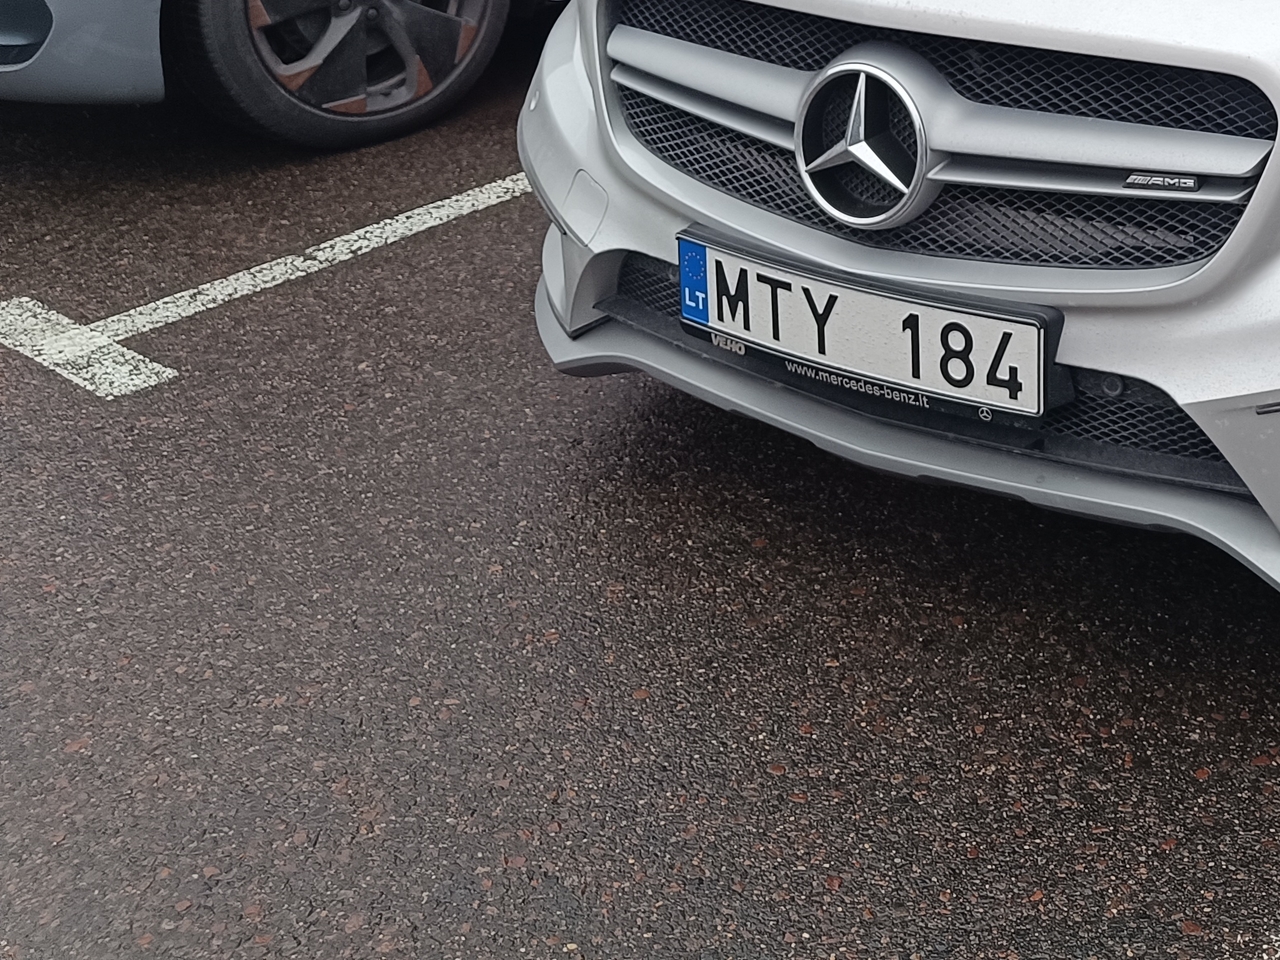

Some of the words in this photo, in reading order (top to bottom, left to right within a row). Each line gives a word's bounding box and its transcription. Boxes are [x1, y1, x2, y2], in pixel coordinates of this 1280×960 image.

[1147, 176, 1195, 188] AMG
[684, 286, 706, 310] LT
[714, 257, 839, 356] MTY
[901, 312, 1023, 401] 184
[710, 333, 746, 356] VEHO
[784, 360, 930, 409] www.mercedes-benz.lt
